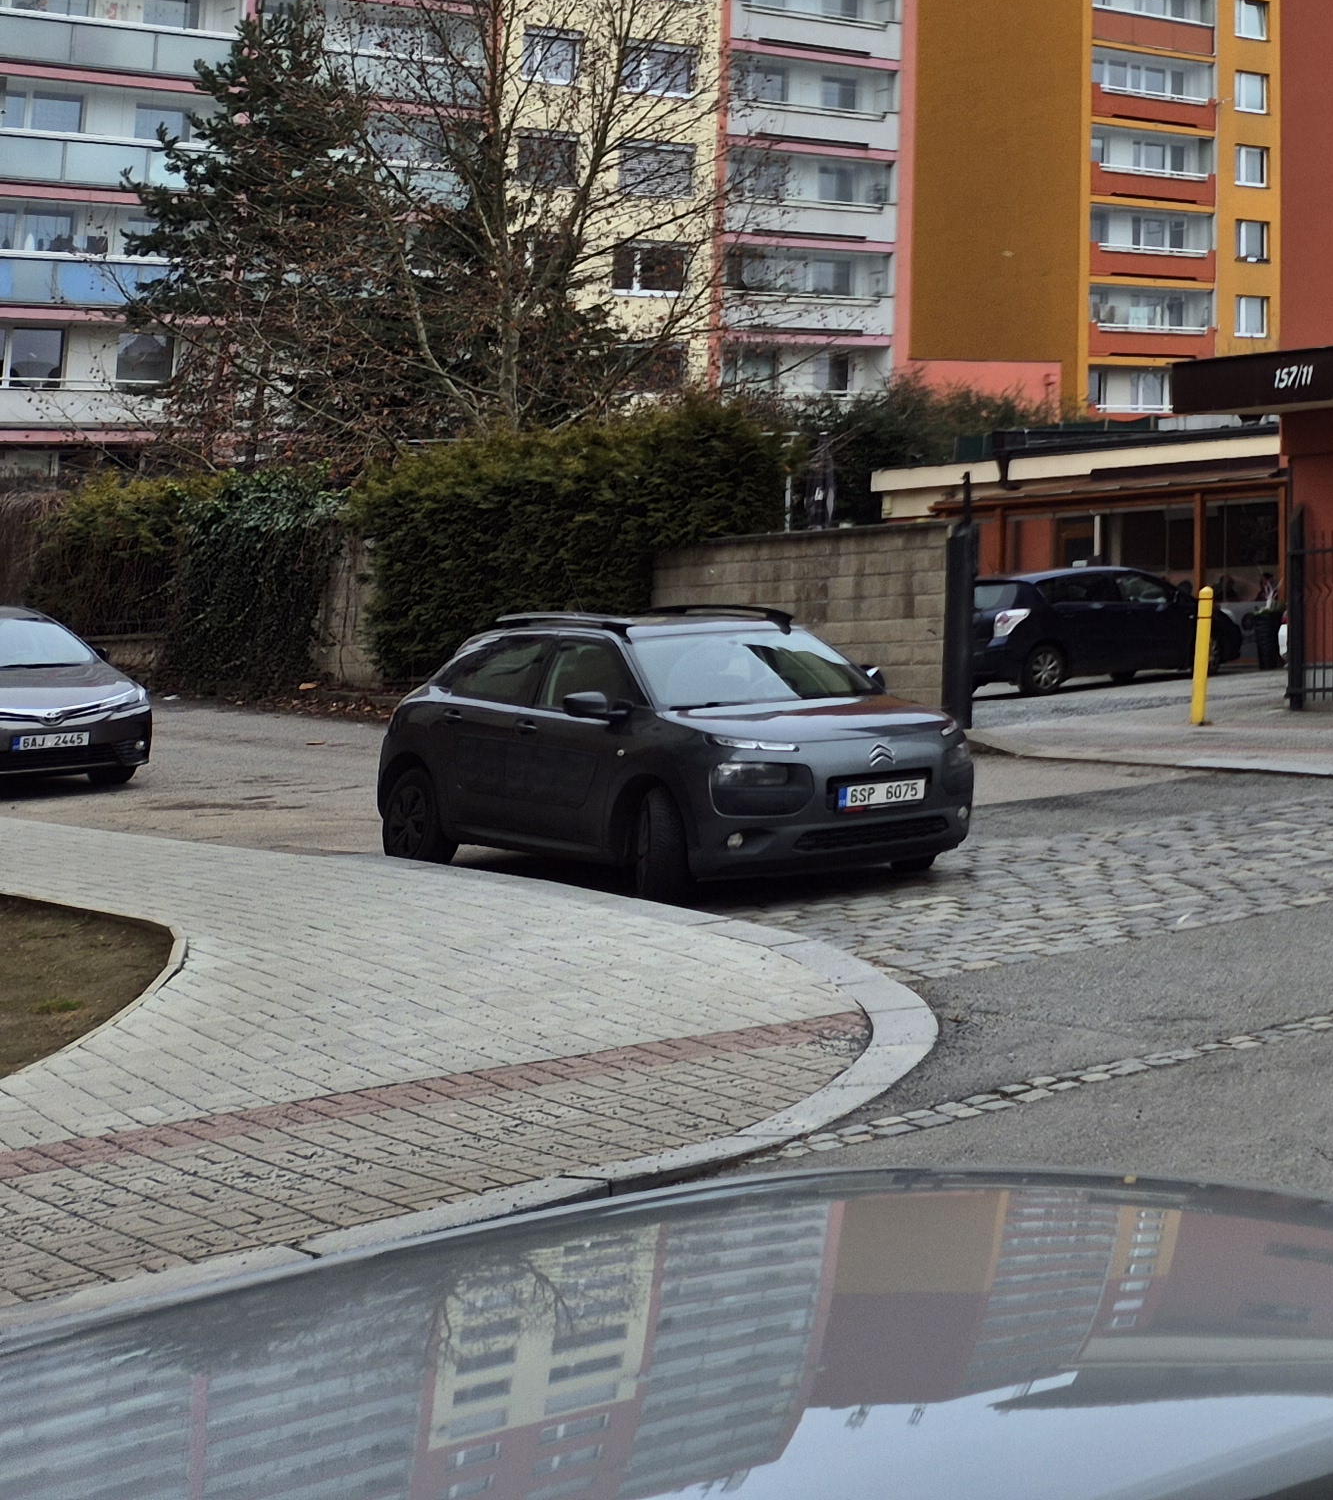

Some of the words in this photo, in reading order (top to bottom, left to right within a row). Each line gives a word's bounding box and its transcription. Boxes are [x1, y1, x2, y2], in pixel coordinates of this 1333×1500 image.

[1274, 364, 1314, 389] 157/11
[22, 737, 46, 749] 6AJ
[54, 733, 84, 747] 2445
[850, 786, 875, 804] 6SP
[886, 782, 918, 800] 6075
